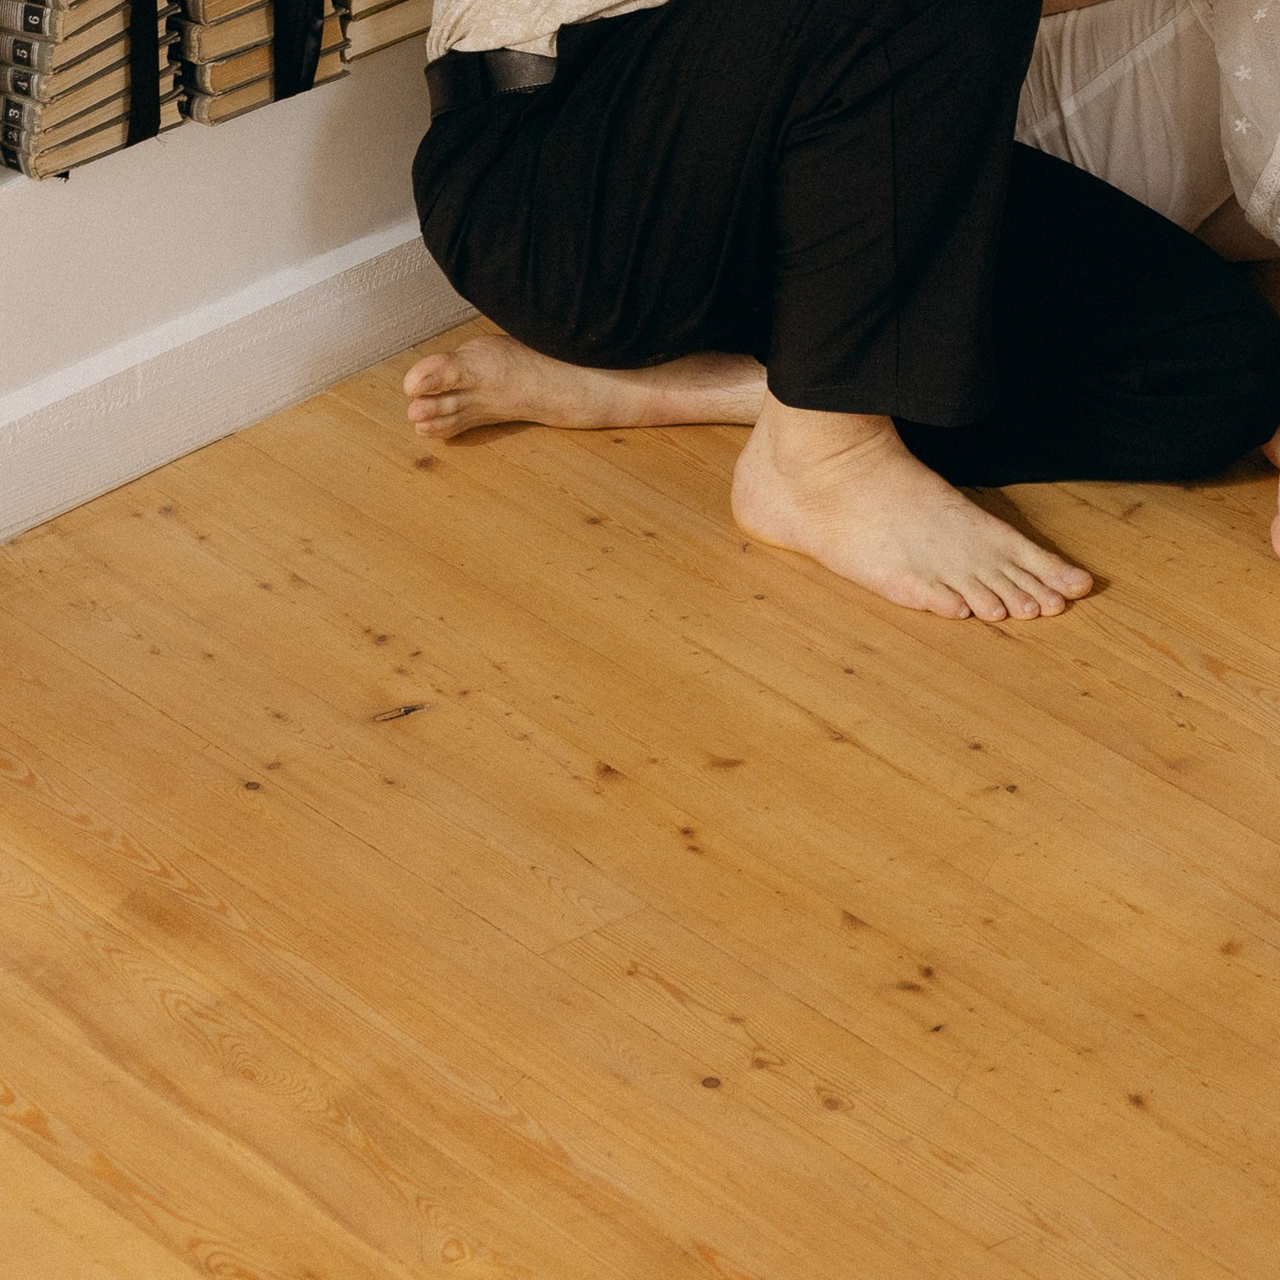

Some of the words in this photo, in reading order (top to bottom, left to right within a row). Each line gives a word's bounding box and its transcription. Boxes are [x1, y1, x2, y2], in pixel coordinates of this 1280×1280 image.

[28, 15, 40, 25] 6
[16, 48, 28, 59] 5
[17, 81, 29, 91] 4
[8, 108, 20, 119] 3
[8, 131, 18, 142] 2
